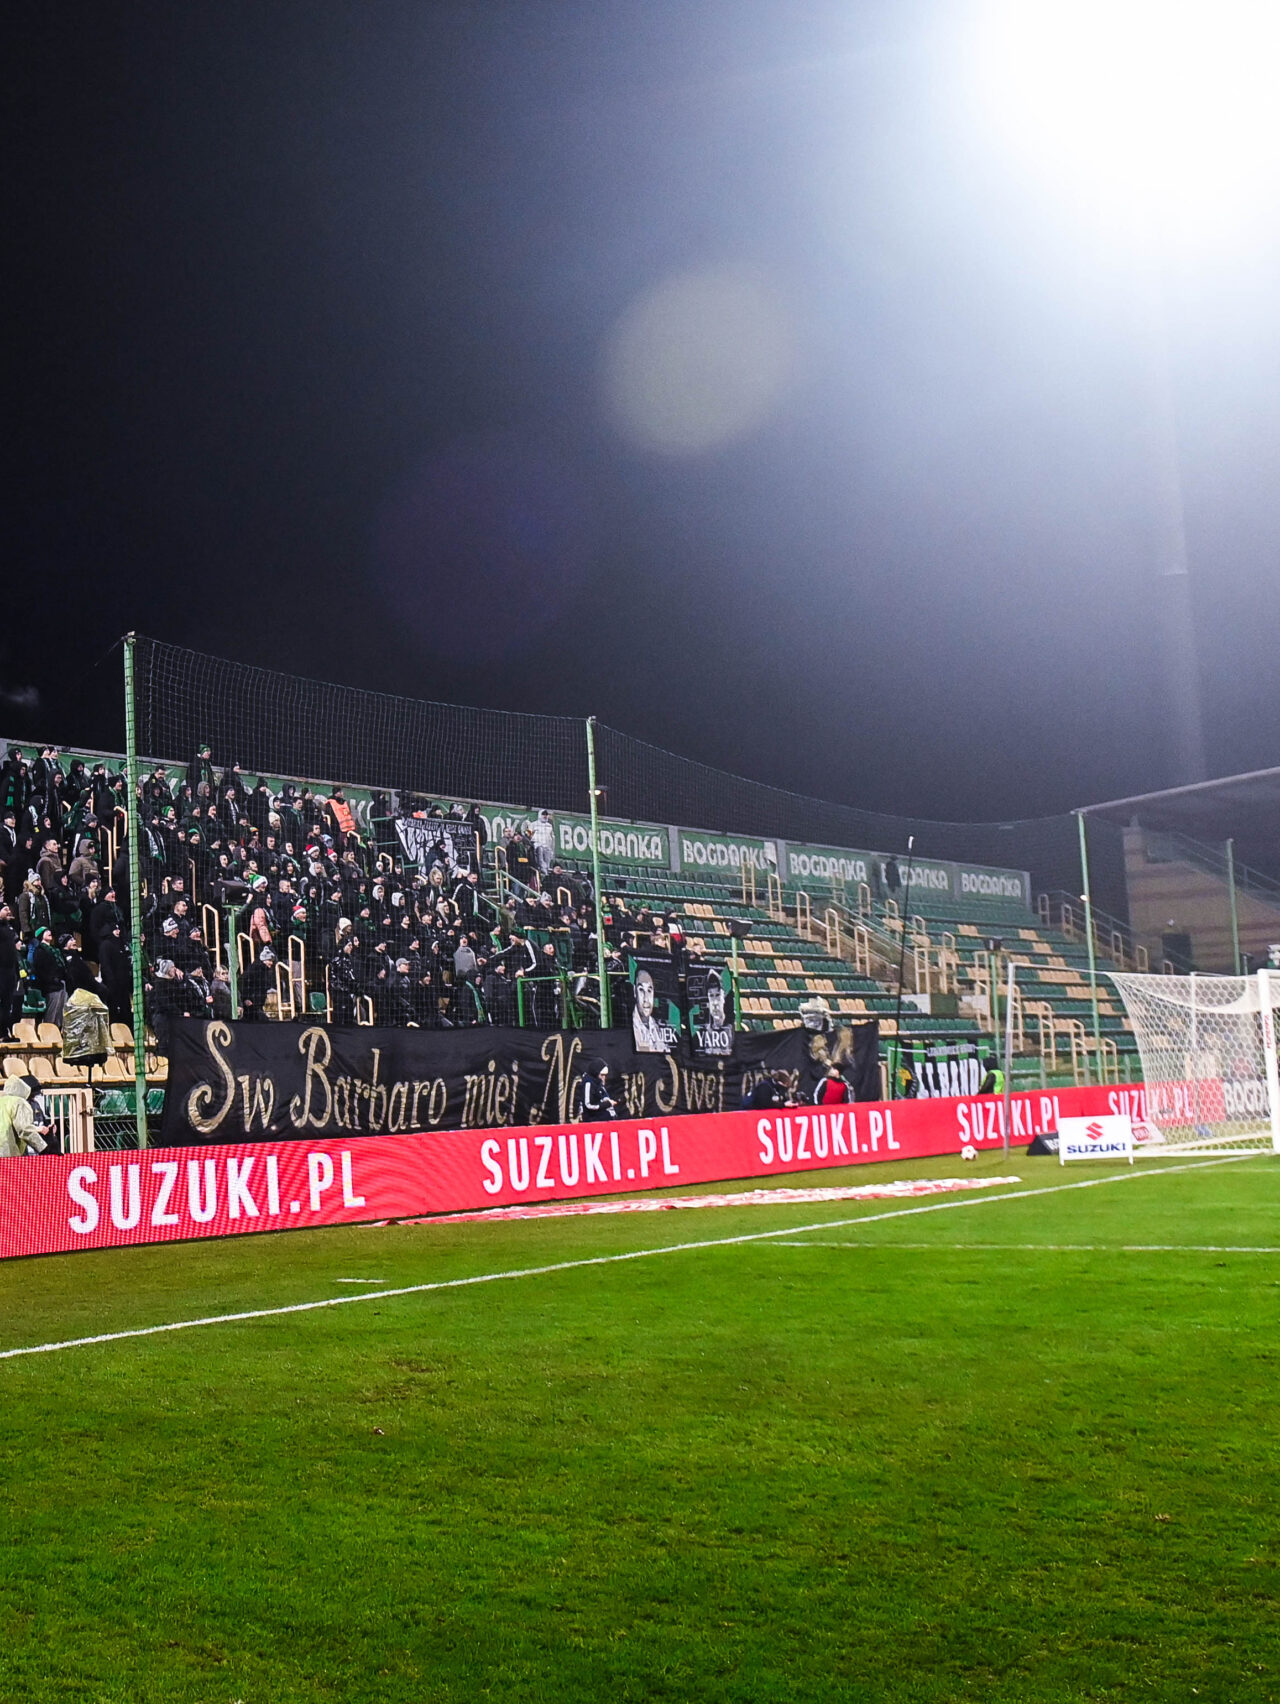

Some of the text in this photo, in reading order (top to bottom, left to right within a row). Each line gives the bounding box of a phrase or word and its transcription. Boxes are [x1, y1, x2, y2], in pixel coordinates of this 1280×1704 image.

[789, 853, 868, 881] BOGDANKA
[880, 863, 949, 890] BGDANKA
[961, 873, 1022, 897] BOGDANKA
[696, 1030, 729, 1048] YARO
[289, 1026, 447, 1133] Barbaro
[757, 1109, 901, 1165] SUZUKI.PL
[1066, 1142, 1126, 1154] SUZUKI
[480, 1126, 680, 1194] SUZUKI.PL
[67, 1150, 366, 1234] SUZUKI.PL
